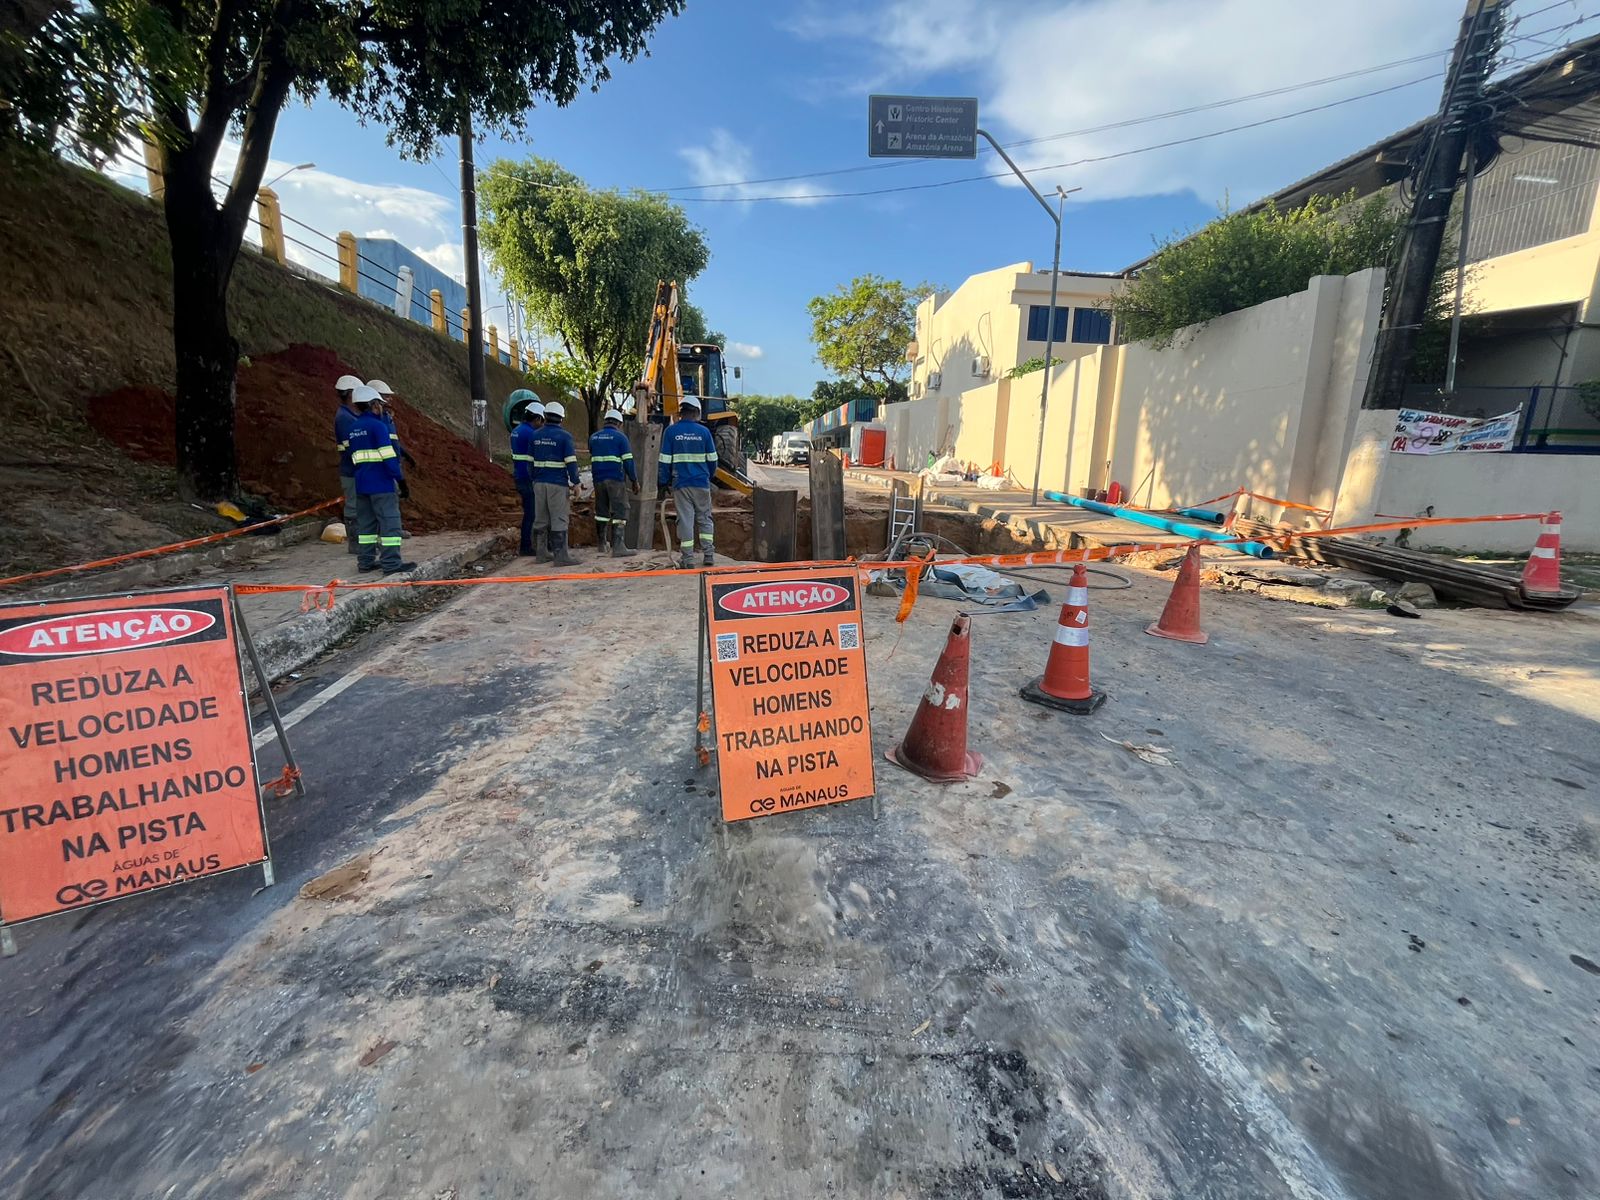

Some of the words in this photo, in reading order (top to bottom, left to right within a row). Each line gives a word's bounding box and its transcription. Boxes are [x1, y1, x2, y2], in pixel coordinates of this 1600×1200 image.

[905, 104, 930, 113] Centro
[905, 114, 934, 123] Historic
[935, 115, 959, 124] Center
[905, 132, 926, 141] Arena
[927, 133, 937, 141] da
[941, 144, 963, 152] Arena
[742, 587, 837, 609] ATENÇÃO
[28, 614, 193, 649] ATENÇÃO
[743, 631, 819, 654] REDUZA
[822, 629, 835, 646] A
[31, 668, 166, 706] REDUZA
[171, 664, 194, 686] A
[729, 657, 849, 687] VELOCIDADE
[753, 689, 832, 716] HOMENS
[9, 697, 219, 749] VELOCIDADE
[722, 716, 864, 752] TRABALHANDO
[54, 738, 193, 783] HOMENS
[756, 758, 783, 780] NA
[788, 751, 839, 776] PISTA
[0, 765, 246, 833] TRABALHANDO
[780, 784, 848, 809] MANAUS
[62, 831, 110, 862] NA
[118, 811, 207, 850] PISTA
[112, 853, 160, 873] ÁGUAS
[163, 849, 180, 862] DE
[115, 855, 221, 893] MANAUS
